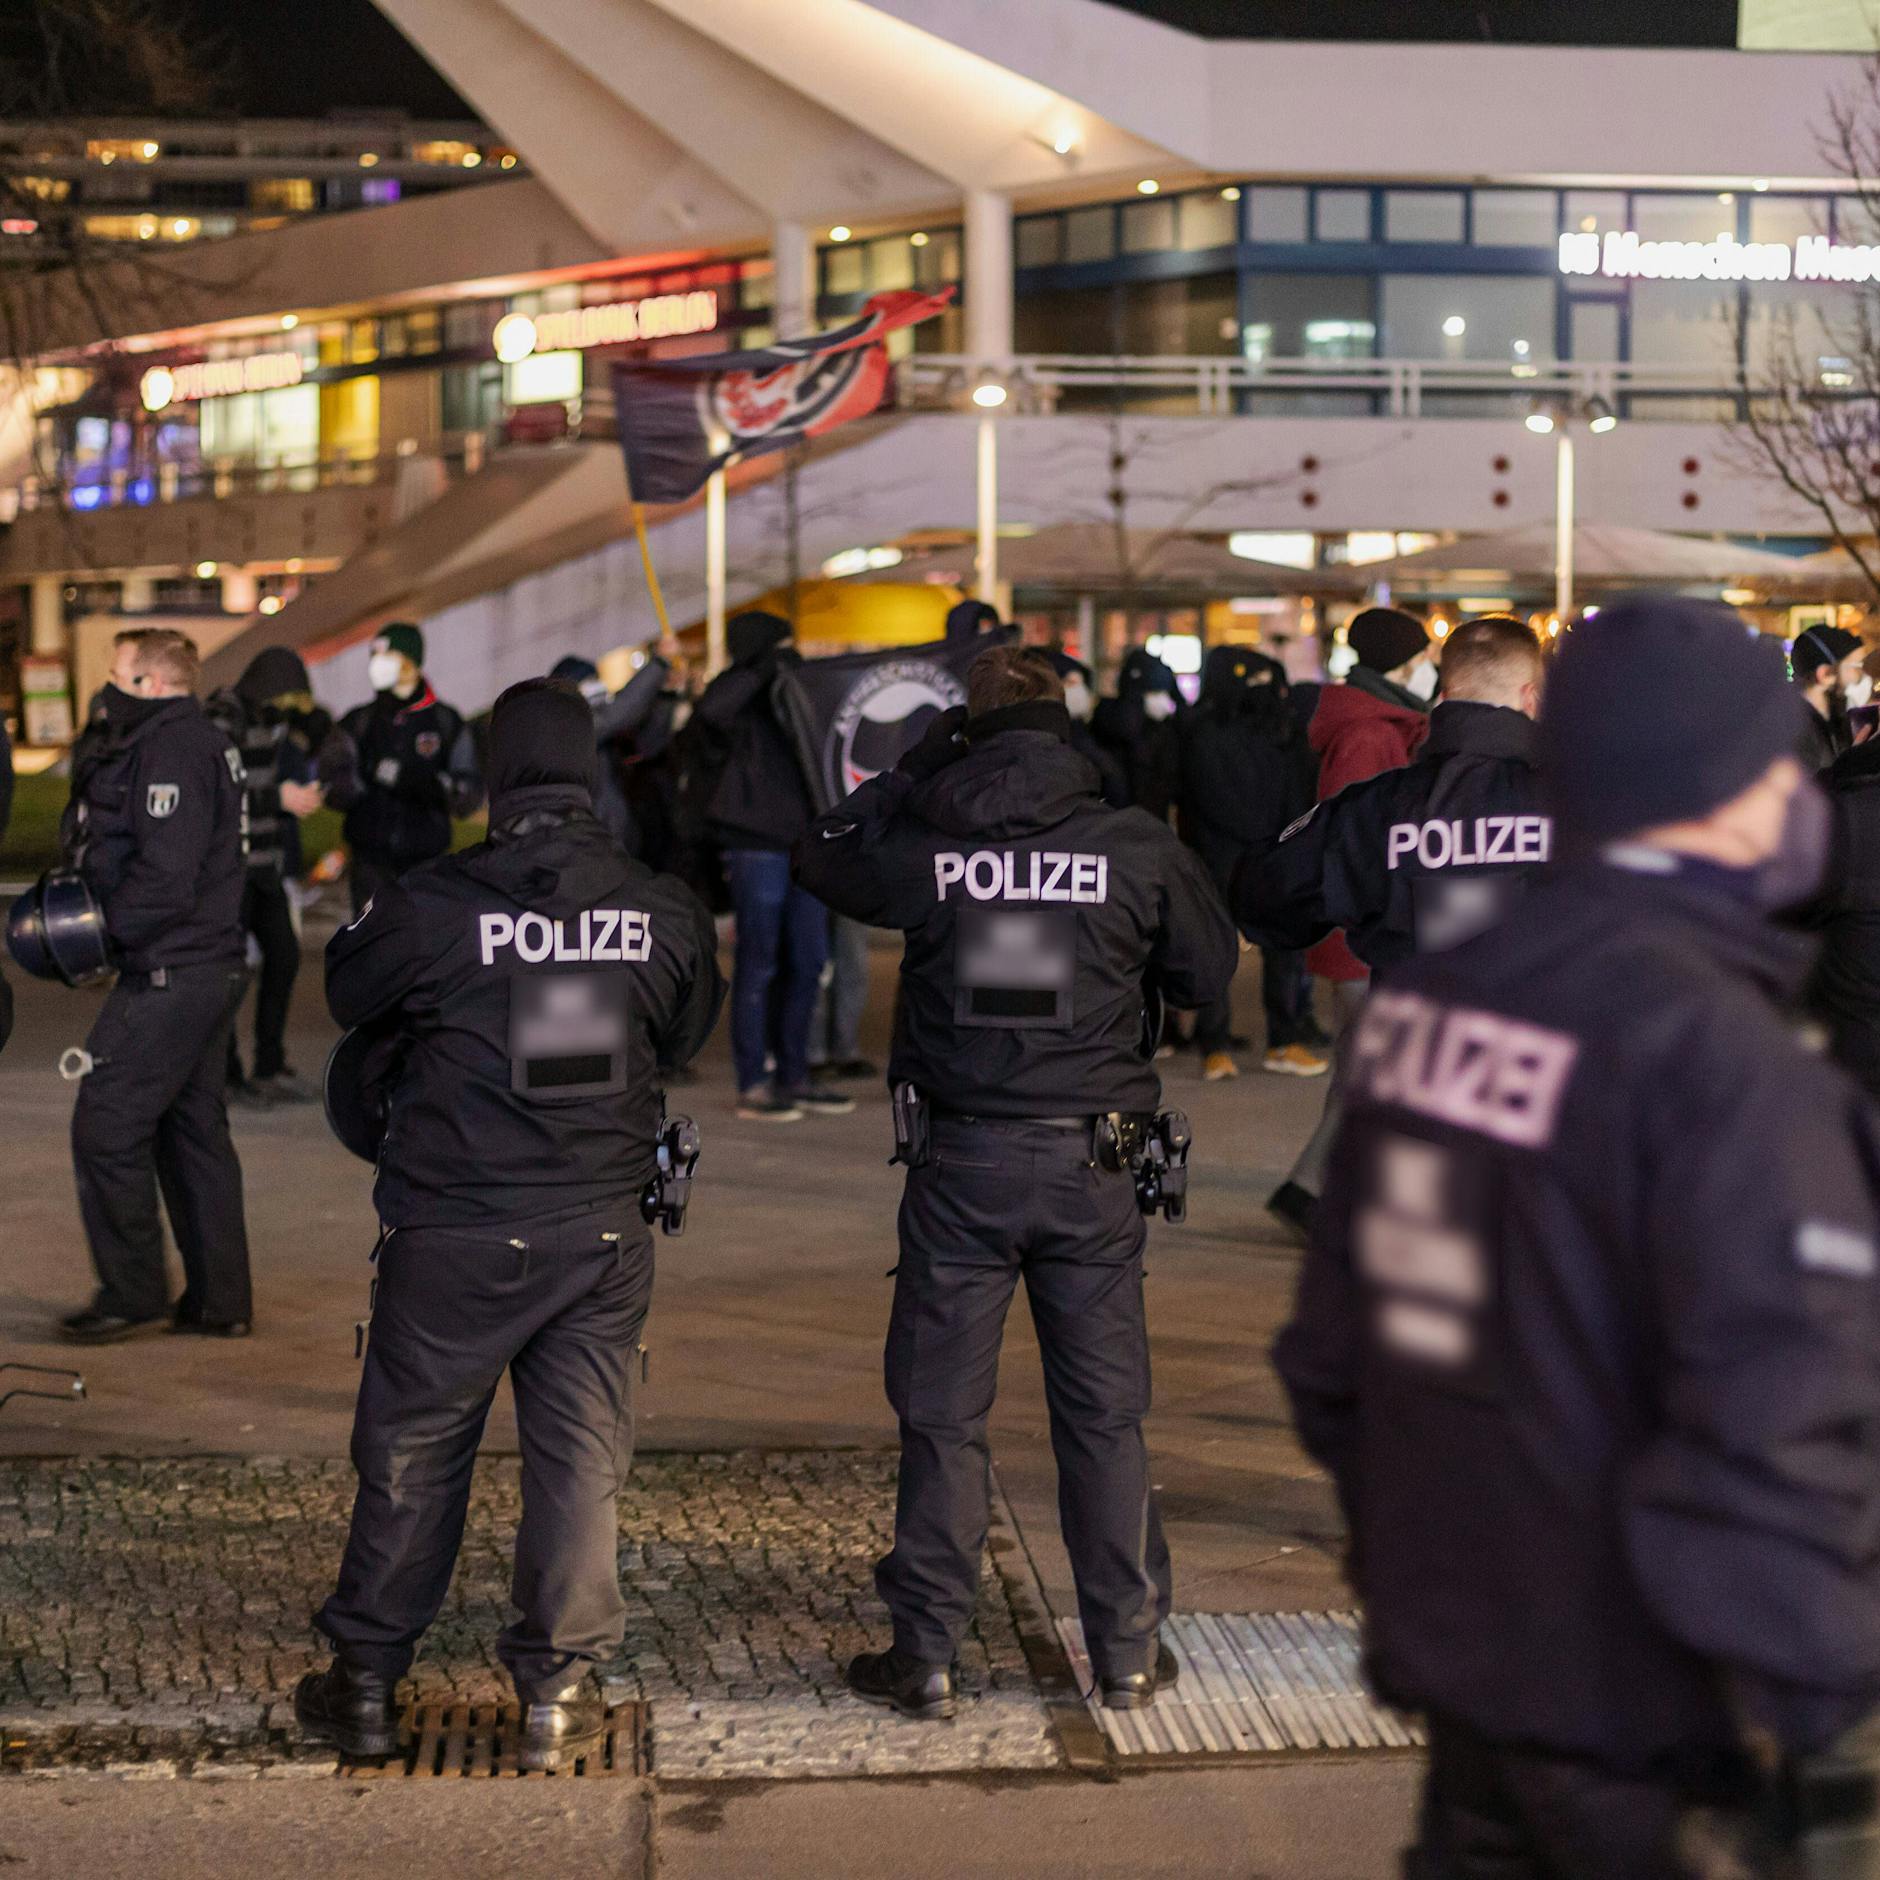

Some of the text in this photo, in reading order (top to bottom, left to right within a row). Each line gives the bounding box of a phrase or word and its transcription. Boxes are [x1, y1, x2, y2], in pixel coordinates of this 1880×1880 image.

[1387, 815, 1552, 870] POLIZEI
[934, 850, 1108, 904] POLIZEI
[479, 909, 653, 966] POLIZEI
